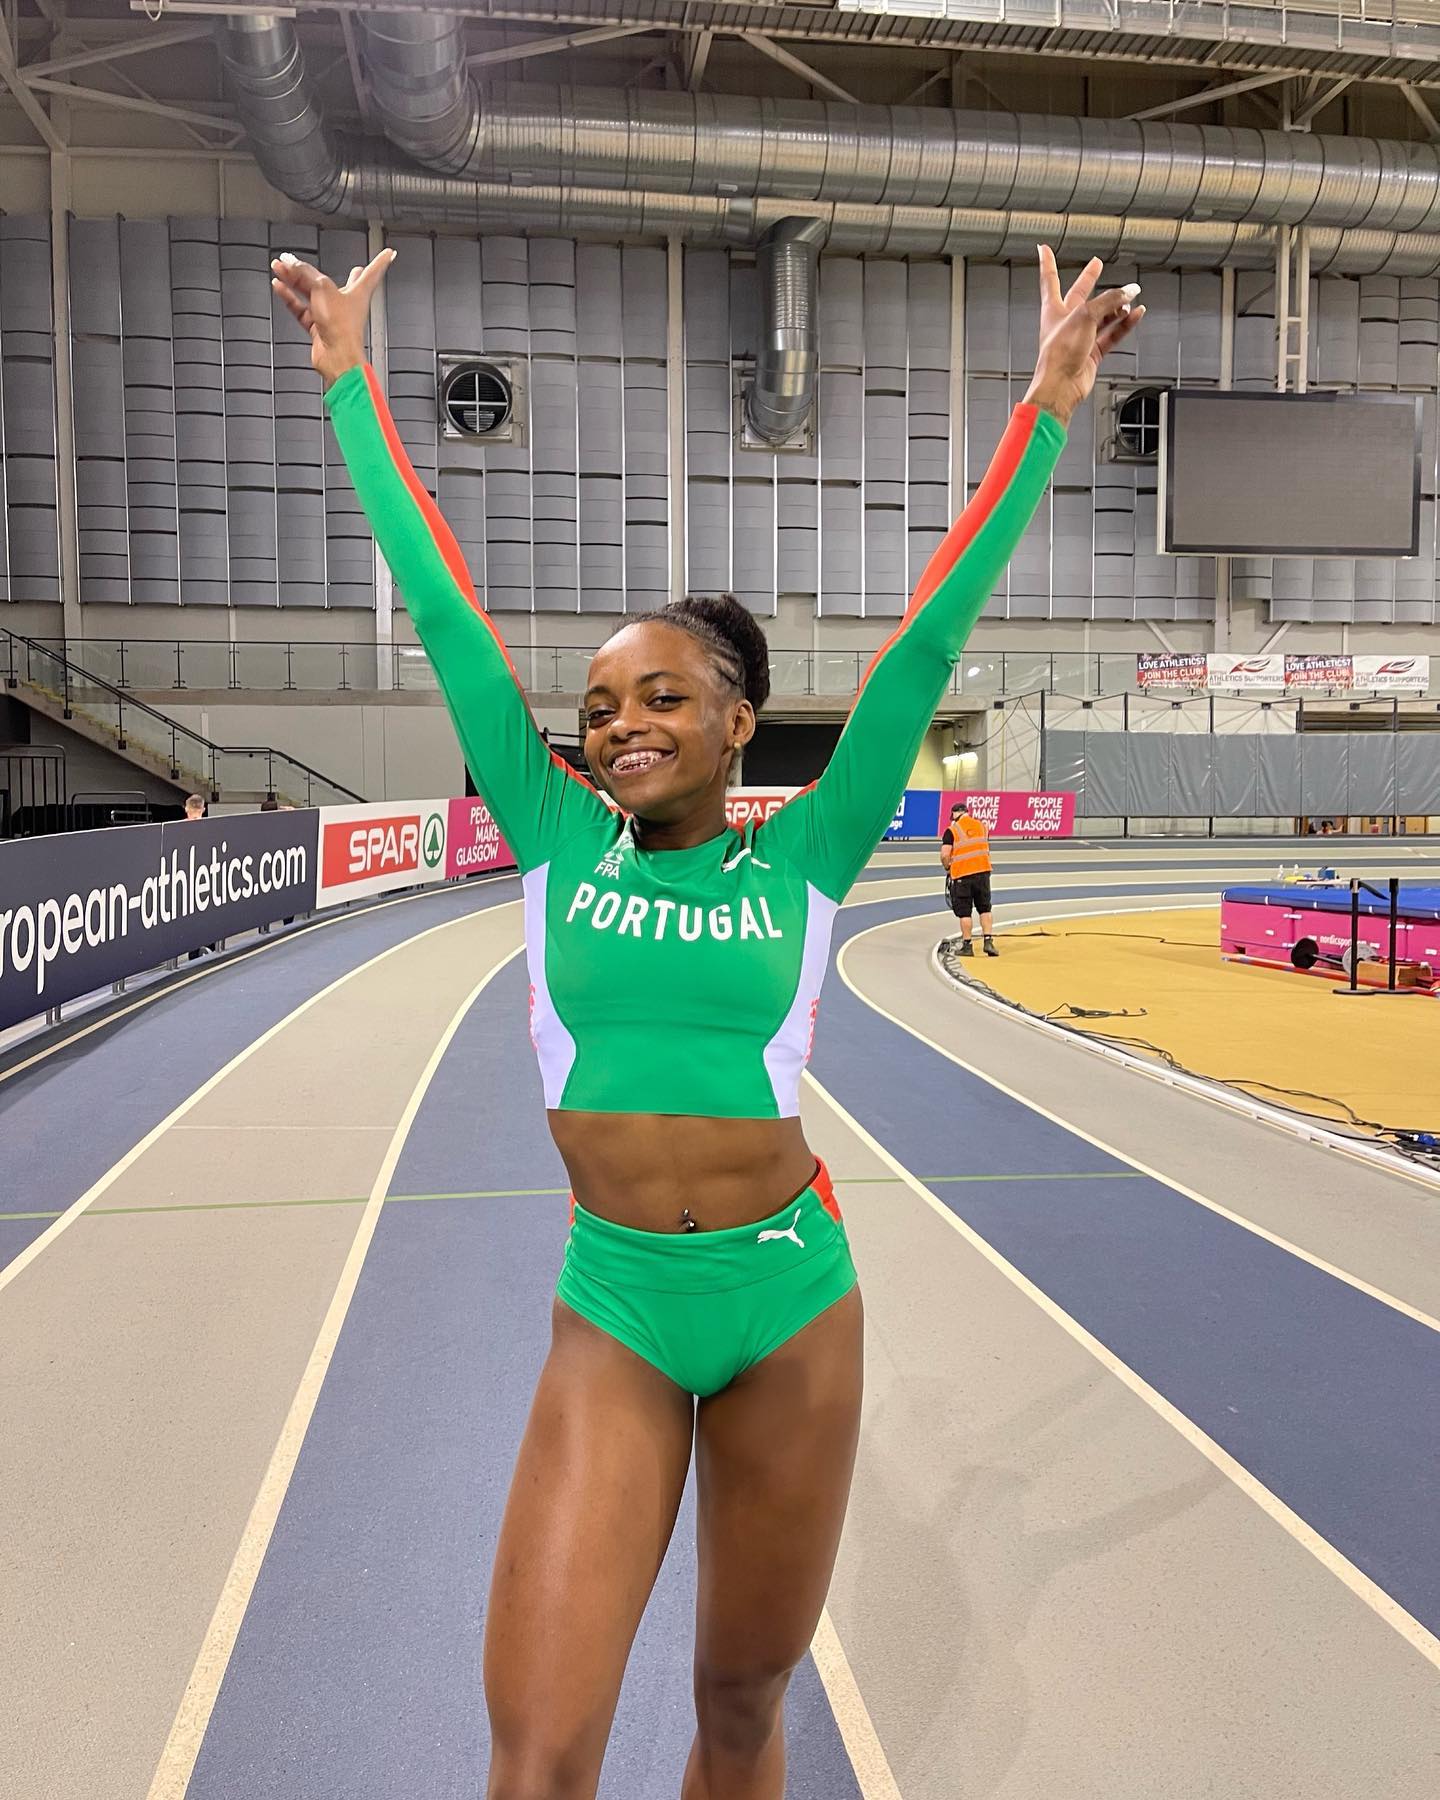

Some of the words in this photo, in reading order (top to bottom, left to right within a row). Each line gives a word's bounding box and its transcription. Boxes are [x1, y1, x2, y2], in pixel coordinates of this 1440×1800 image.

[1138, 660, 1159, 670] LOVE
[1159, 657, 1205, 669] ATHLETICS?
[1285, 661, 1305, 671] LOVE
[1305, 659, 1351, 670] ATHLETICS?
[1143, 671, 1161, 680] JOIN
[1161, 669, 1179, 679] THE
[1179, 667, 1204, 677] CLUB!
[1209, 674, 1243, 682] ATHLETICS
[1290, 671, 1308, 681] JOIN
[1308, 670, 1325, 680] THE
[966, 796, 1000, 809] PEOPLE
[1027, 796, 1063, 809] PEOPLE
[972, 808, 999, 820] MAKE
[1033, 808, 1062, 820] MAKE
[1011, 819, 1061, 831] GLASGOW
[475, 823, 500, 844] MAKE
[348, 823, 418, 874] SPAR
[456, 841, 499, 866] GLASGOW
[594, 861, 620, 880] FPA
[565, 881, 783, 942] PORTUGAL
